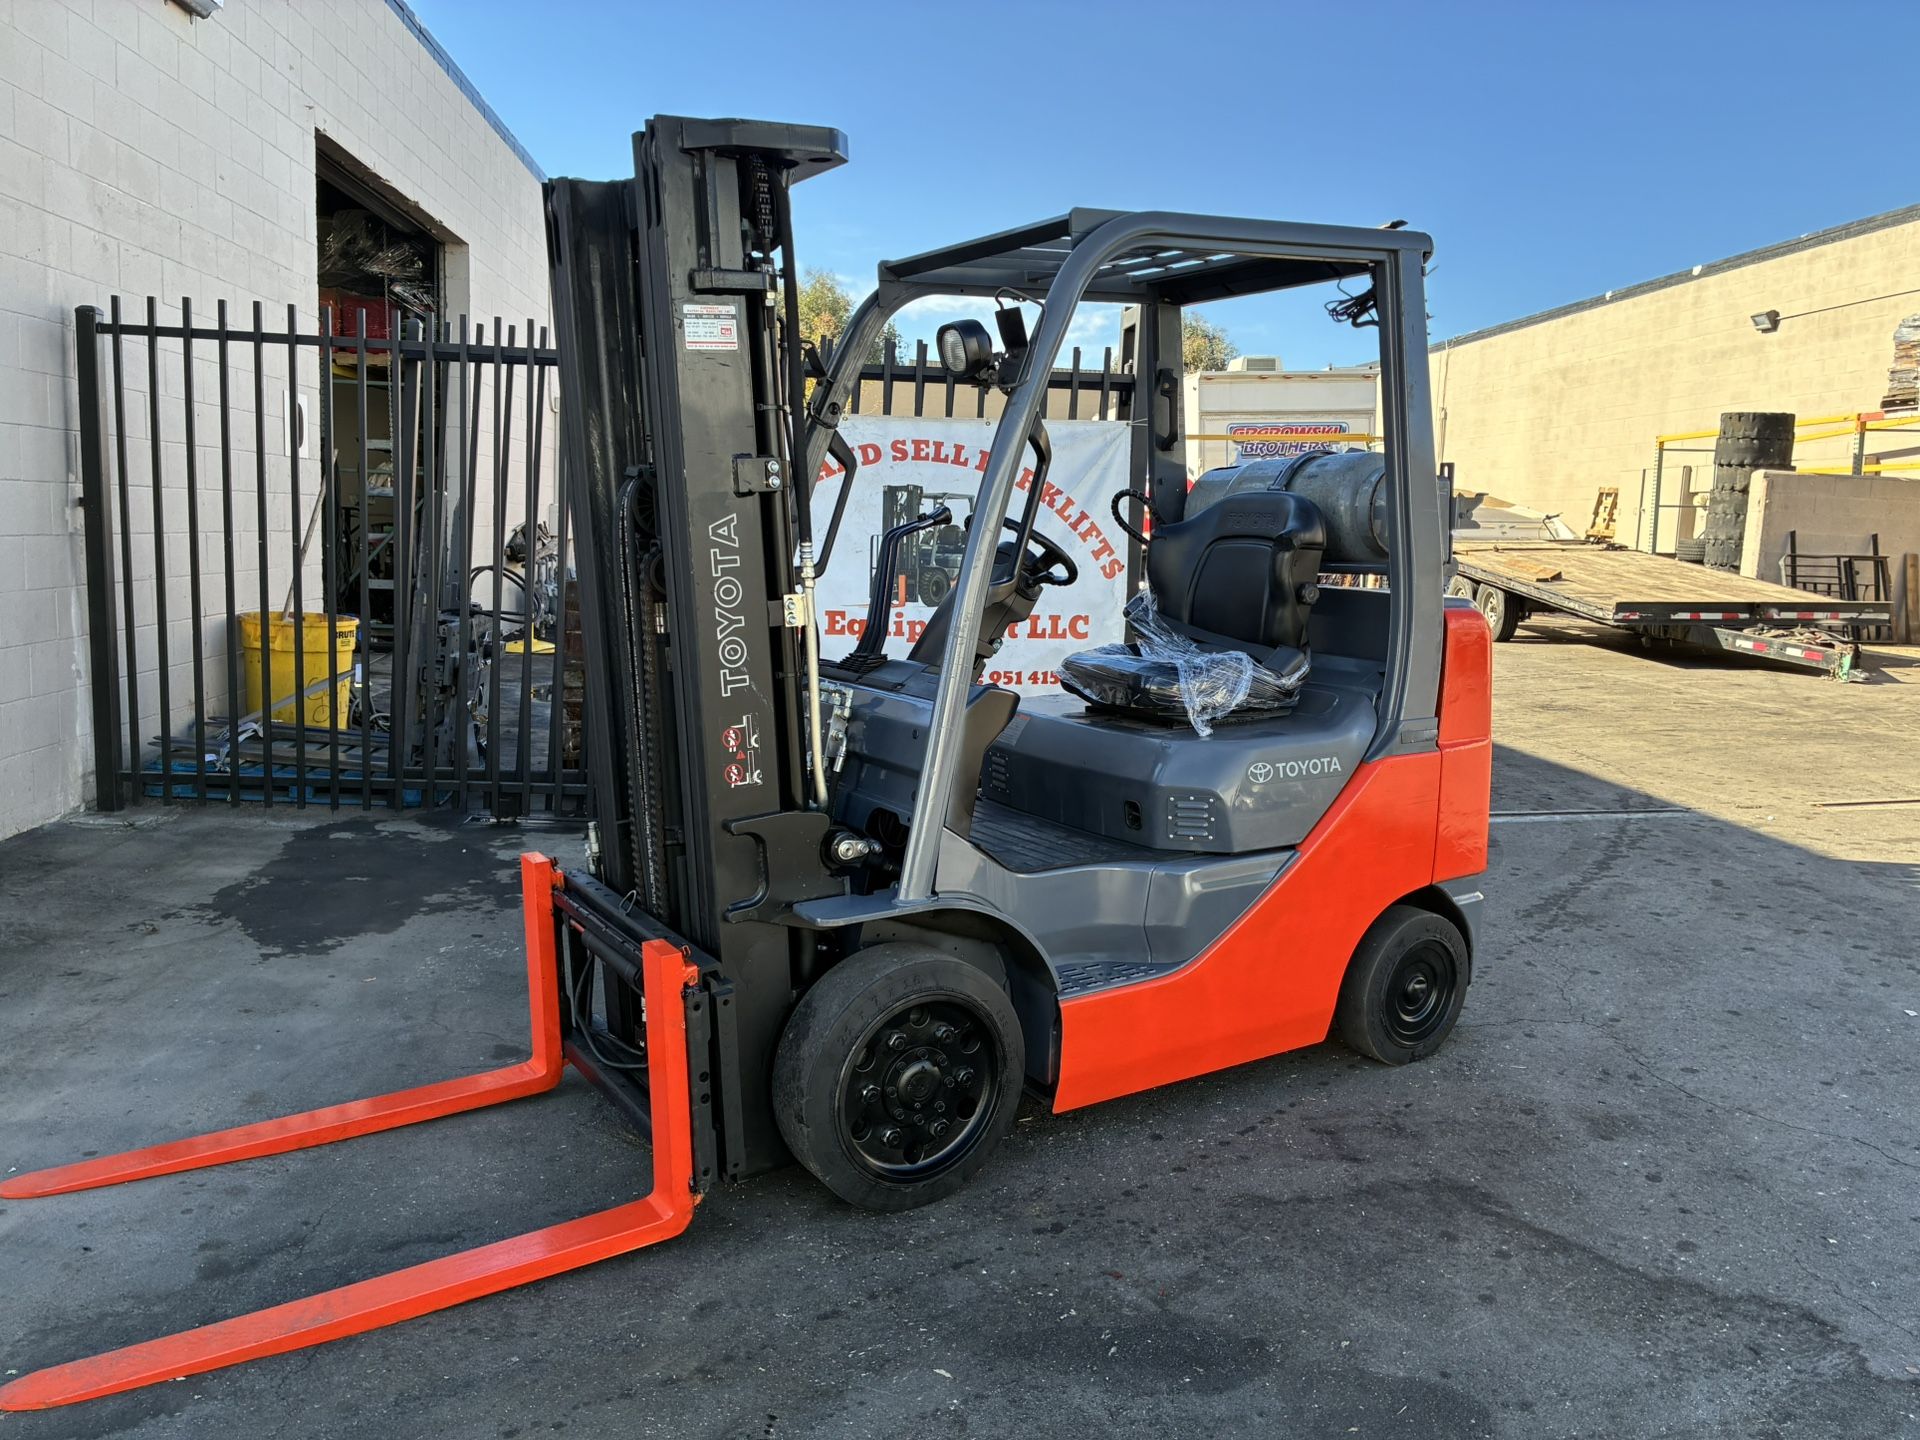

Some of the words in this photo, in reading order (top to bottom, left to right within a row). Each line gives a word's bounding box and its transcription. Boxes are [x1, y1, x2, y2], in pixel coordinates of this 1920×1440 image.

[1242, 441, 1330, 455] BROTHERS
[816, 443, 882, 482] AD
[890, 439, 969, 467] SELL
[974, 449, 1125, 580] RKLIFTS
[1226, 511, 1282, 530] TOYOTA
[709, 512, 750, 697] TOYOTA
[1026, 614, 1090, 640] LLC
[988, 670, 1023, 686] 951
[1275, 756, 1342, 779] TOYOTA
